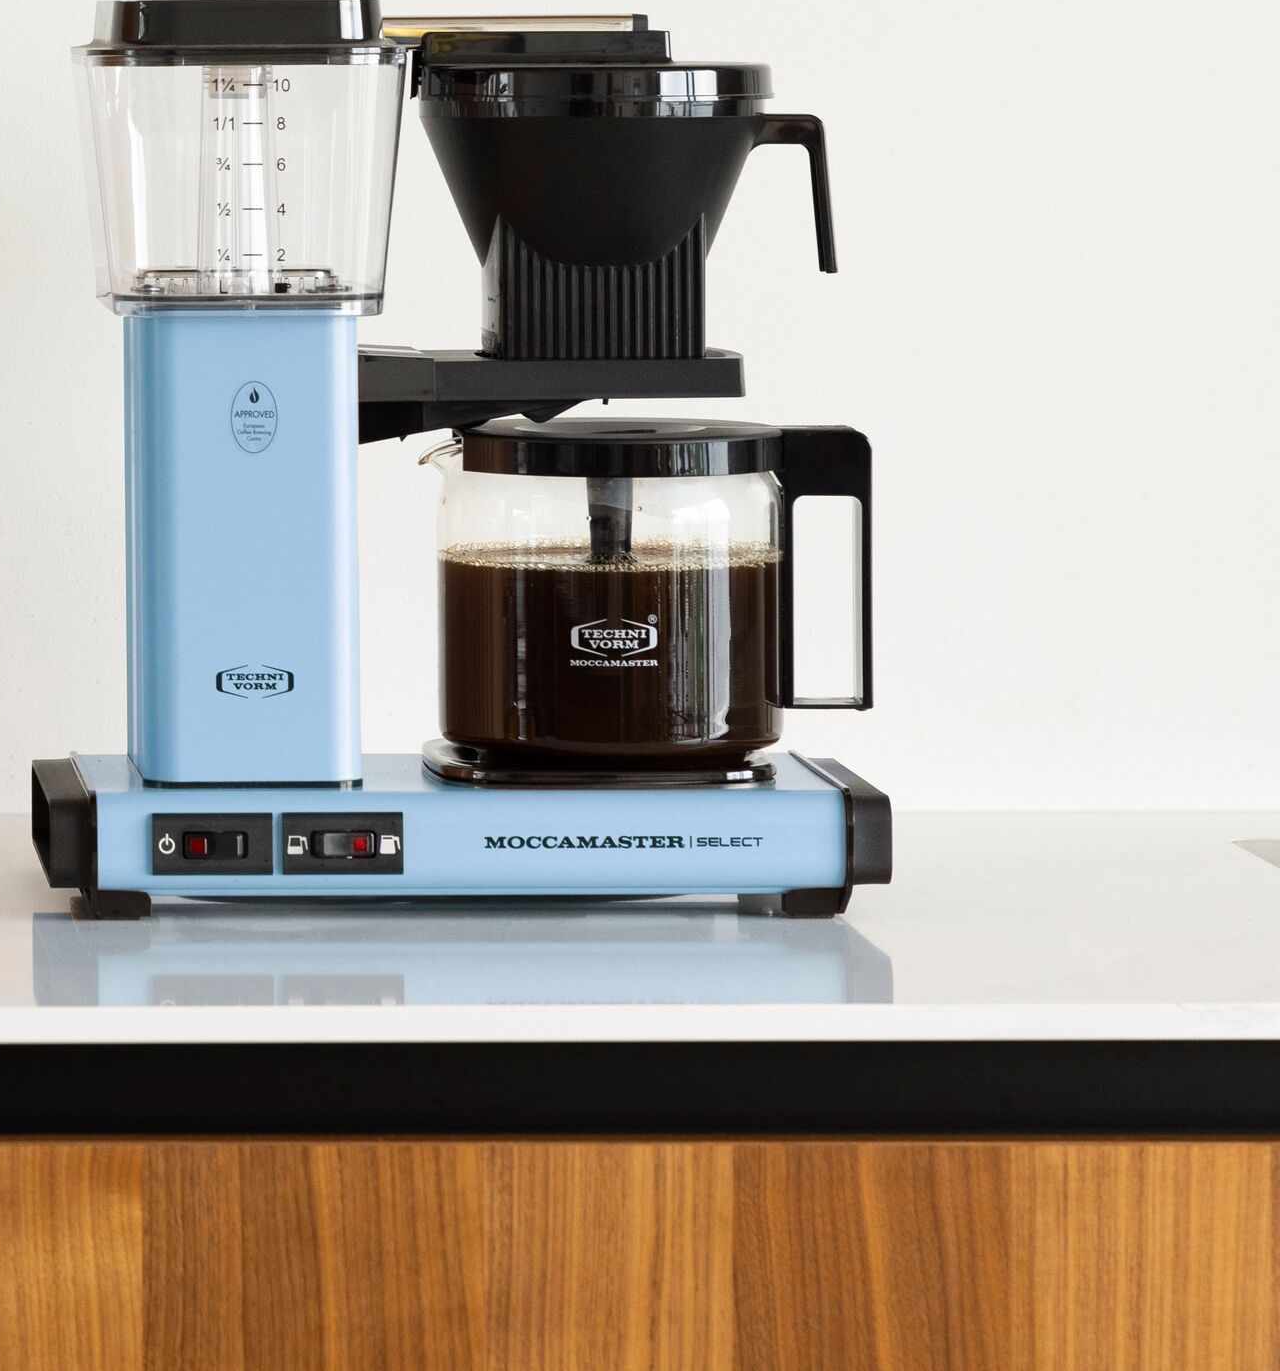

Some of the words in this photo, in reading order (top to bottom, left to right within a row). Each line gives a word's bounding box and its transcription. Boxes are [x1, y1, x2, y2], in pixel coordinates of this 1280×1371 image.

[272, 78, 291, 92] 10
[212, 116, 236, 131] 1/1
[276, 116, 286, 131] 8
[276, 157, 286, 171] 6
[276, 202, 286, 216] 4
[276, 248, 286, 262] 2
[234, 410, 275, 419] APPROVED
[581, 629, 647, 639] TECHNI
[588, 639, 640, 649] VORM
[569, 659, 659, 667] MOCCAMASTER
[225, 673, 285, 681] TECHNI
[232, 682, 278, 691] VORM
[484, 835, 686, 849] MOCCAMASTER
[696, 836, 764, 848] SELECT
